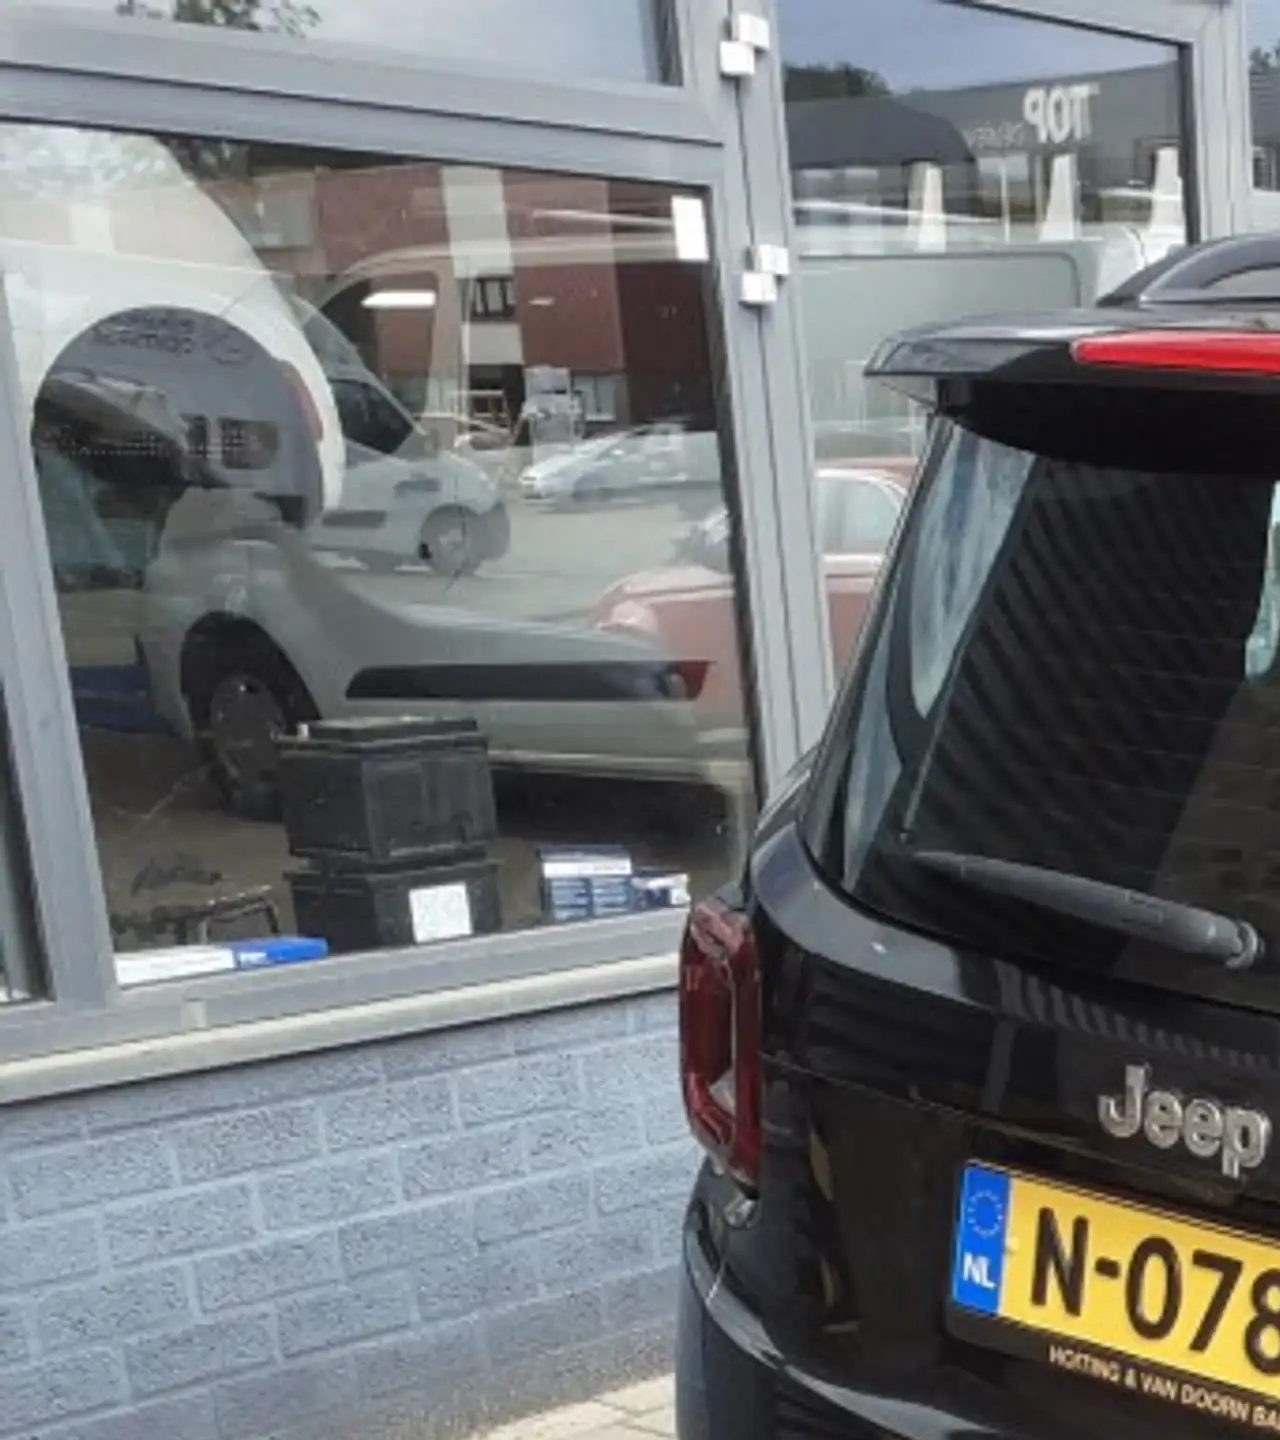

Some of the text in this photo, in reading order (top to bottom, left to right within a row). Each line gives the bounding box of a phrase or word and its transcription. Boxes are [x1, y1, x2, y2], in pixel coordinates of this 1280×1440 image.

[1098, 1063, 1273, 1177] Jeep
[962, 1250, 996, 1290] NL
[1124, 1366, 1138, 1390] &
[1139, 1371, 1179, 1401] VAN
[1181, 1383, 1250, 1424] DOORN
